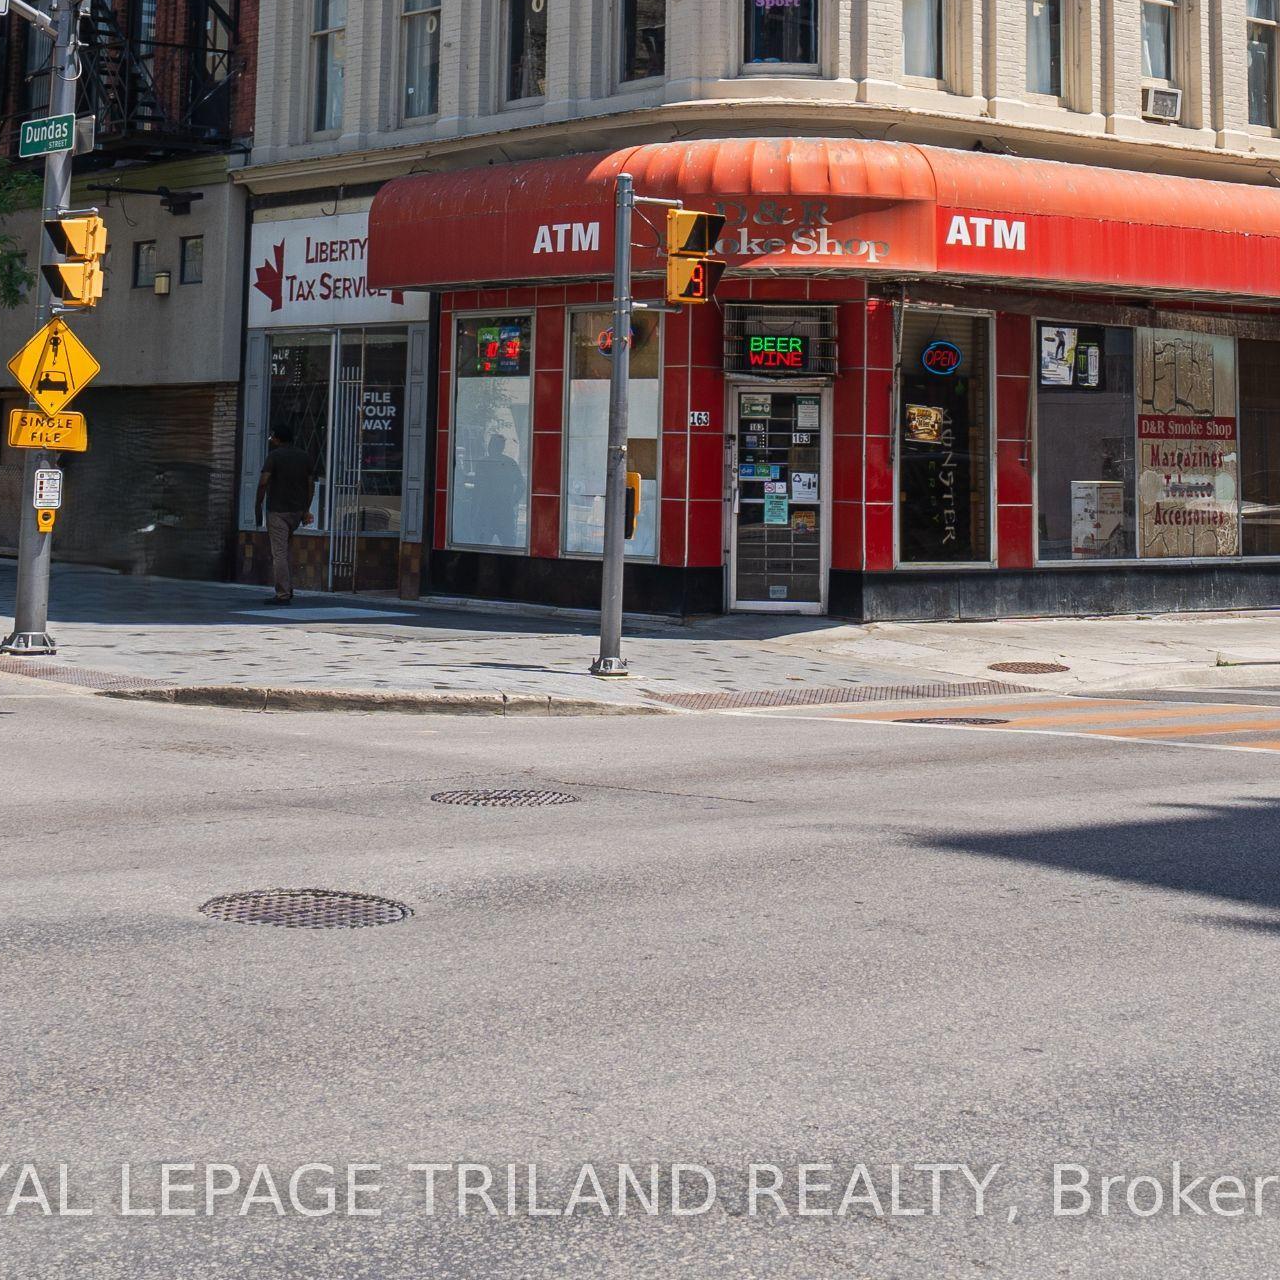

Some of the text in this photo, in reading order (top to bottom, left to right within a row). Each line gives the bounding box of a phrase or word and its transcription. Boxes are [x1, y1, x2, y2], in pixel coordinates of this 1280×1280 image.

[26, 121, 68, 143] Dundas
[49, 138, 67, 148] STREET
[712, 201, 747, 225] D
[799, 201, 832, 225] R
[532, 222, 600, 255] ATM
[945, 215, 1026, 251] ATM
[306, 236, 368, 264] LIBERTY
[791, 227, 890, 263] Shop
[285, 274, 316, 301] TAX
[691, 264, 703, 297] 9
[750, 337, 802, 352] BEER
[750, 351, 803, 366] WINE
[926, 350, 957, 366] OPEN
[363, 392, 391, 403] FILE
[357, 406, 396, 417] YOUR
[690, 412, 709, 425] 163
[20, 416, 73, 429] SINGLE
[1141, 420, 1232, 438] D&R Smoke Shop
[31, 432, 61, 443] FILE
[793, 433, 811, 444] 163
[1154, 502, 1224, 526] Accessories
